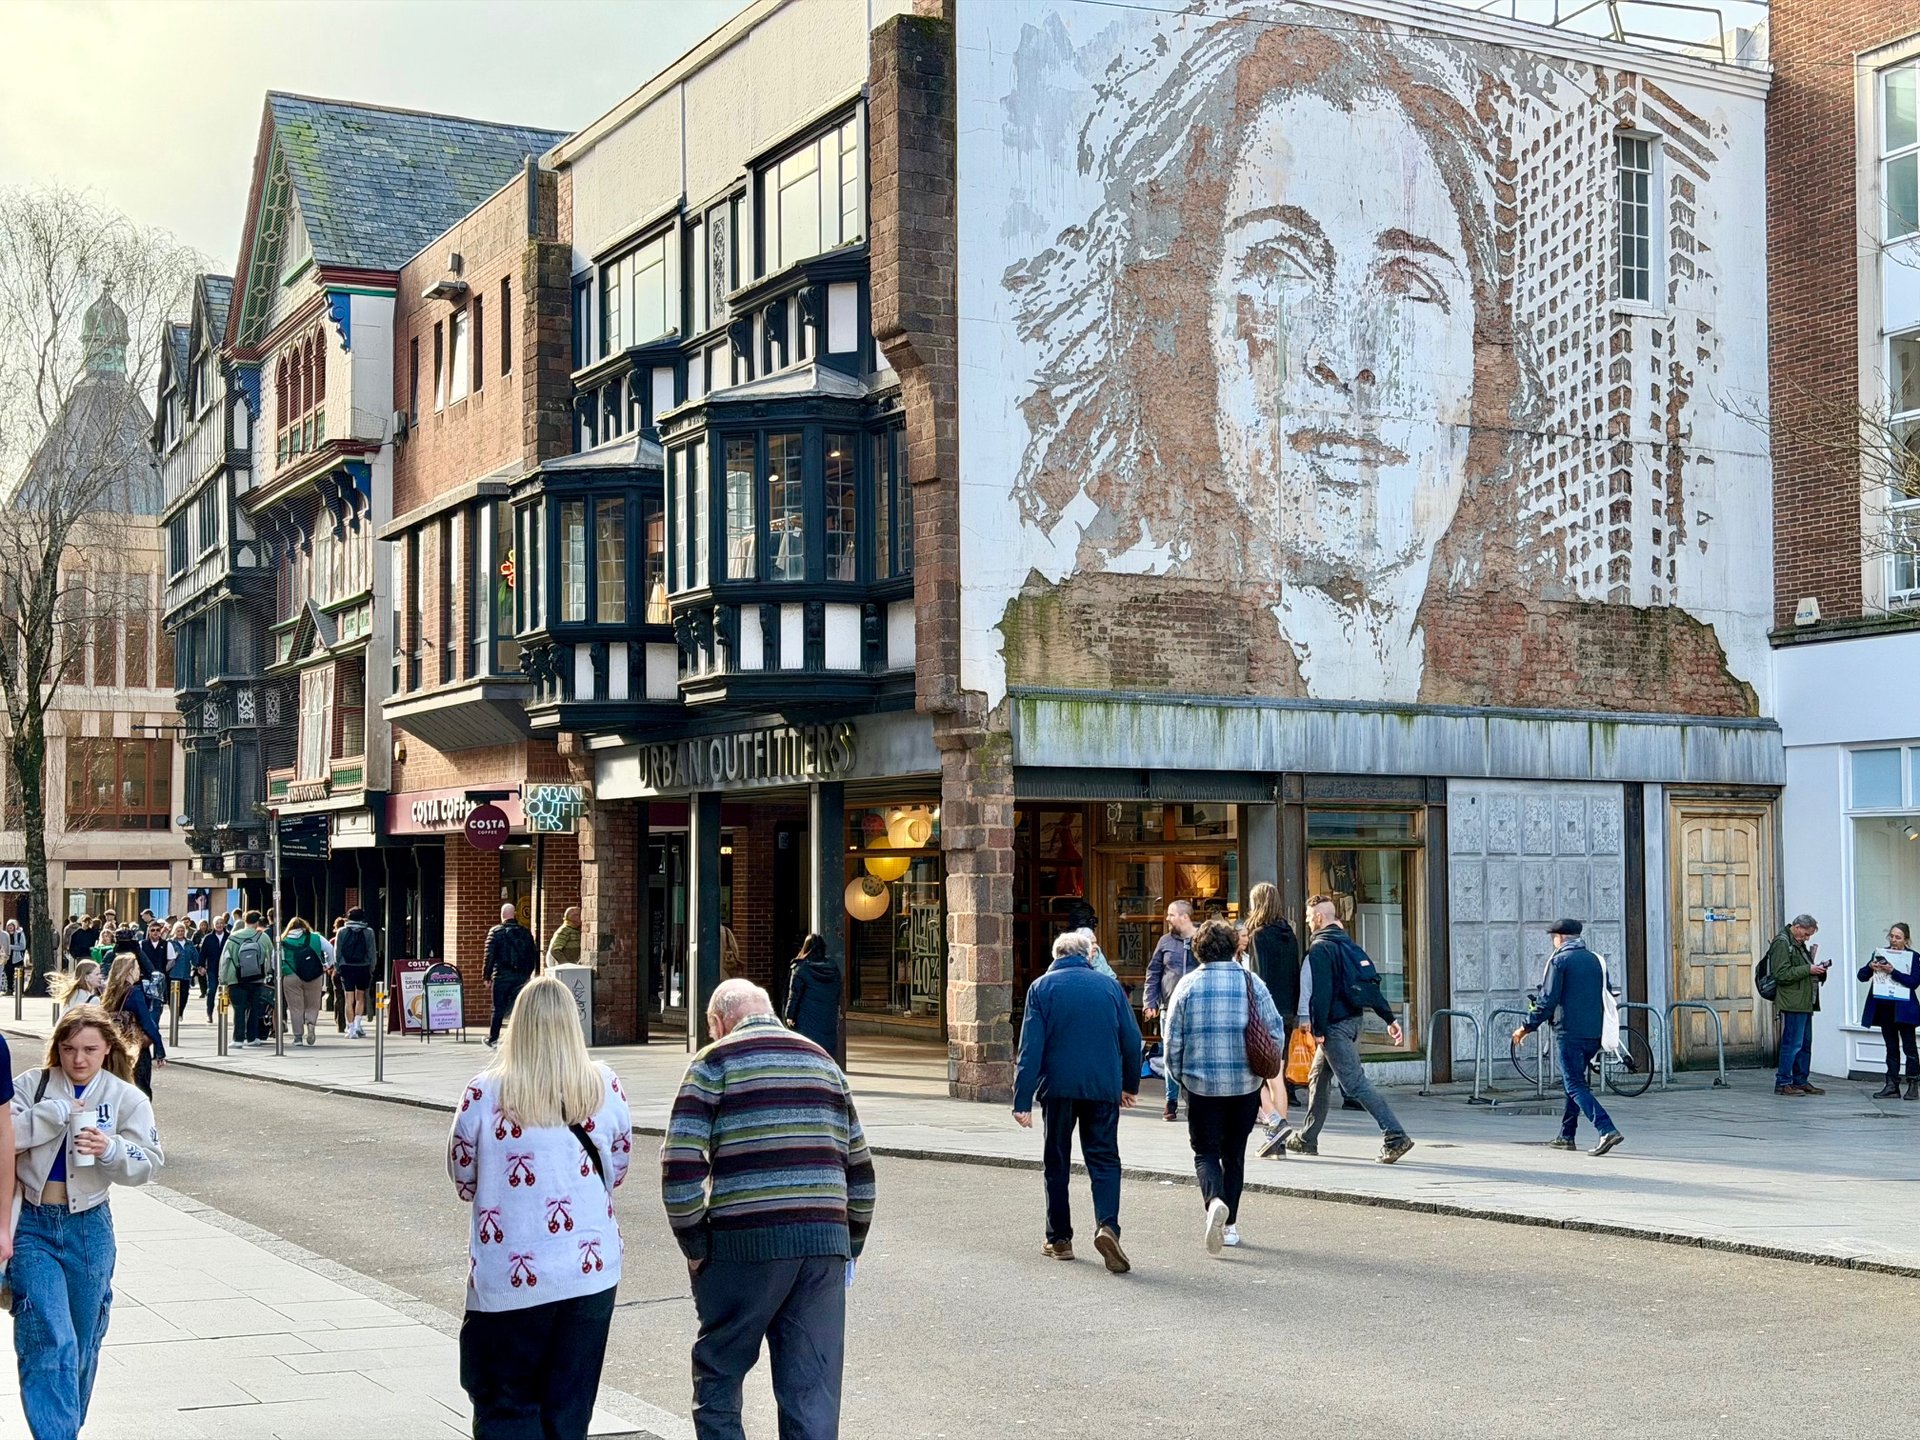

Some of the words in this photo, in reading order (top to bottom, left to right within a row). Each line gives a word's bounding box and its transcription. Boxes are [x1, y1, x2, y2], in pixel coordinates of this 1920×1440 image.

[639, 739, 706, 789] URBAN
[709, 721, 857, 782] OUTFITTERS
[527, 786, 583, 801] URBAN
[411, 800, 438, 823] COSTA
[526, 800, 585, 816] OUTFIT
[469, 820, 505, 829] COSTA
